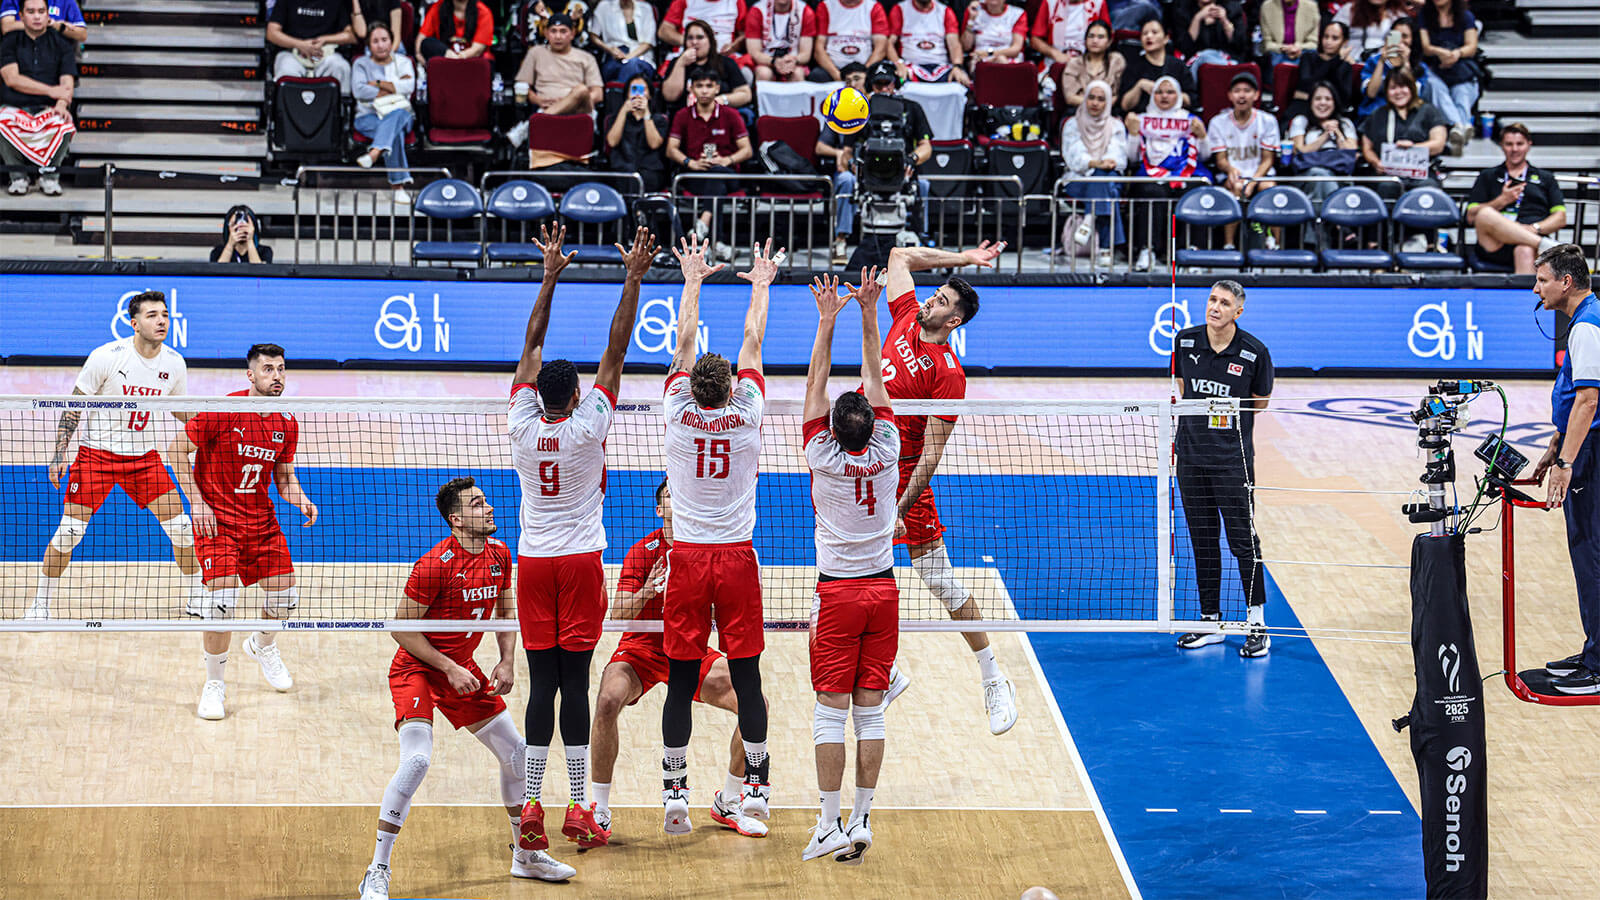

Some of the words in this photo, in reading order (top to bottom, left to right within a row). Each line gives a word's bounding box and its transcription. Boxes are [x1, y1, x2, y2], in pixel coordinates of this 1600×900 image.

[1143, 116, 1189, 131] POLAND
[893, 334, 920, 378] VESTEL
[1191, 378, 1232, 398] VESTEL
[87, 401, 123, 409] CHAMPIONSHIP
[124, 401, 138, 409] 2025
[127, 411, 150, 432] 19
[237, 443, 276, 462] VESTEL
[537, 437, 559, 452] LEON
[694, 438, 731, 479] 15
[70, 482, 79, 493] 19
[539, 461, 560, 497] 9
[854, 477, 877, 516] 4
[462, 585, 498, 602] VESTEL
[287, 621, 315, 629] VOLLEYBALL
[316, 621, 334, 629] WORLD
[334, 621, 371, 629] CHAMPIONSHIP
[371, 621, 385, 629] 2025
[412, 697, 420, 708] 7
[1445, 702, 1469, 715] 2025
[1445, 773, 1467, 872] Senoh
